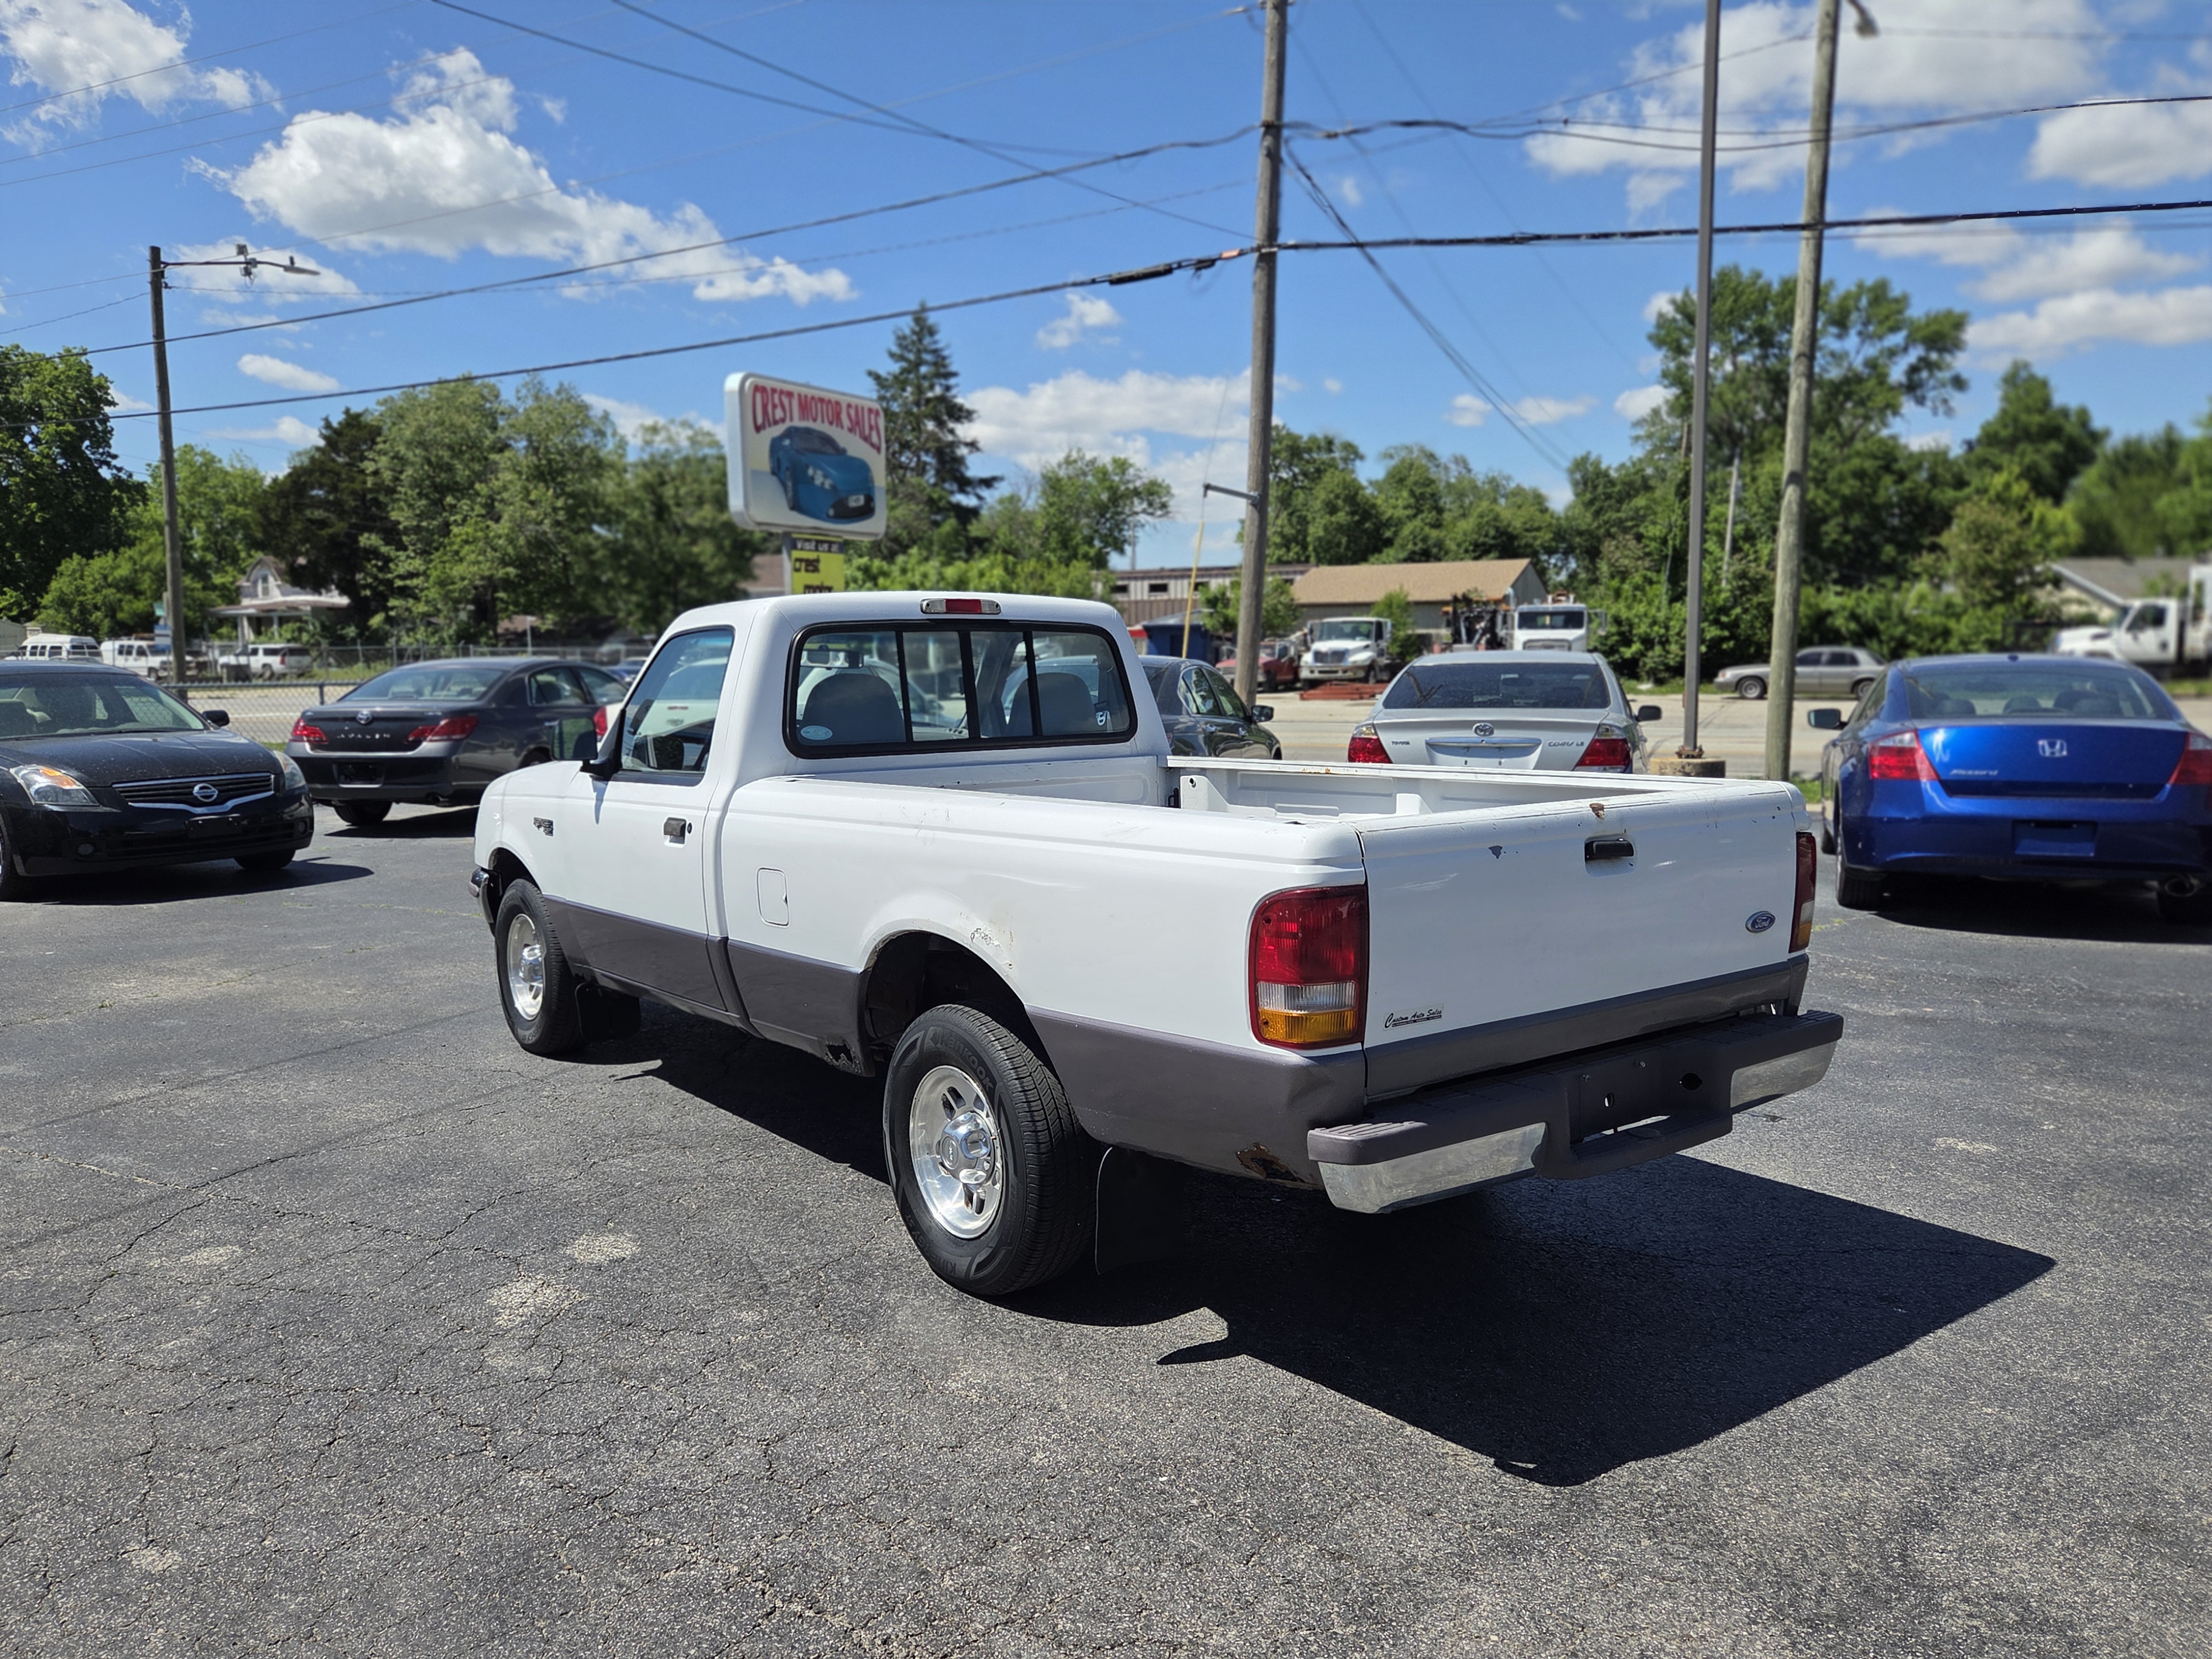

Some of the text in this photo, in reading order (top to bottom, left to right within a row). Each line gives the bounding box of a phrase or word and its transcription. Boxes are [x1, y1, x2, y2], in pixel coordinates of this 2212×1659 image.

[752, 384, 882, 455] CREST MOTOR SALES
[796, 540, 816, 551] Visit
[818, 542, 829, 552] us
[794, 555, 820, 573] crest
[1384, 1013, 1409, 1029] Custom
[1410, 1011, 1425, 1020] Auto
